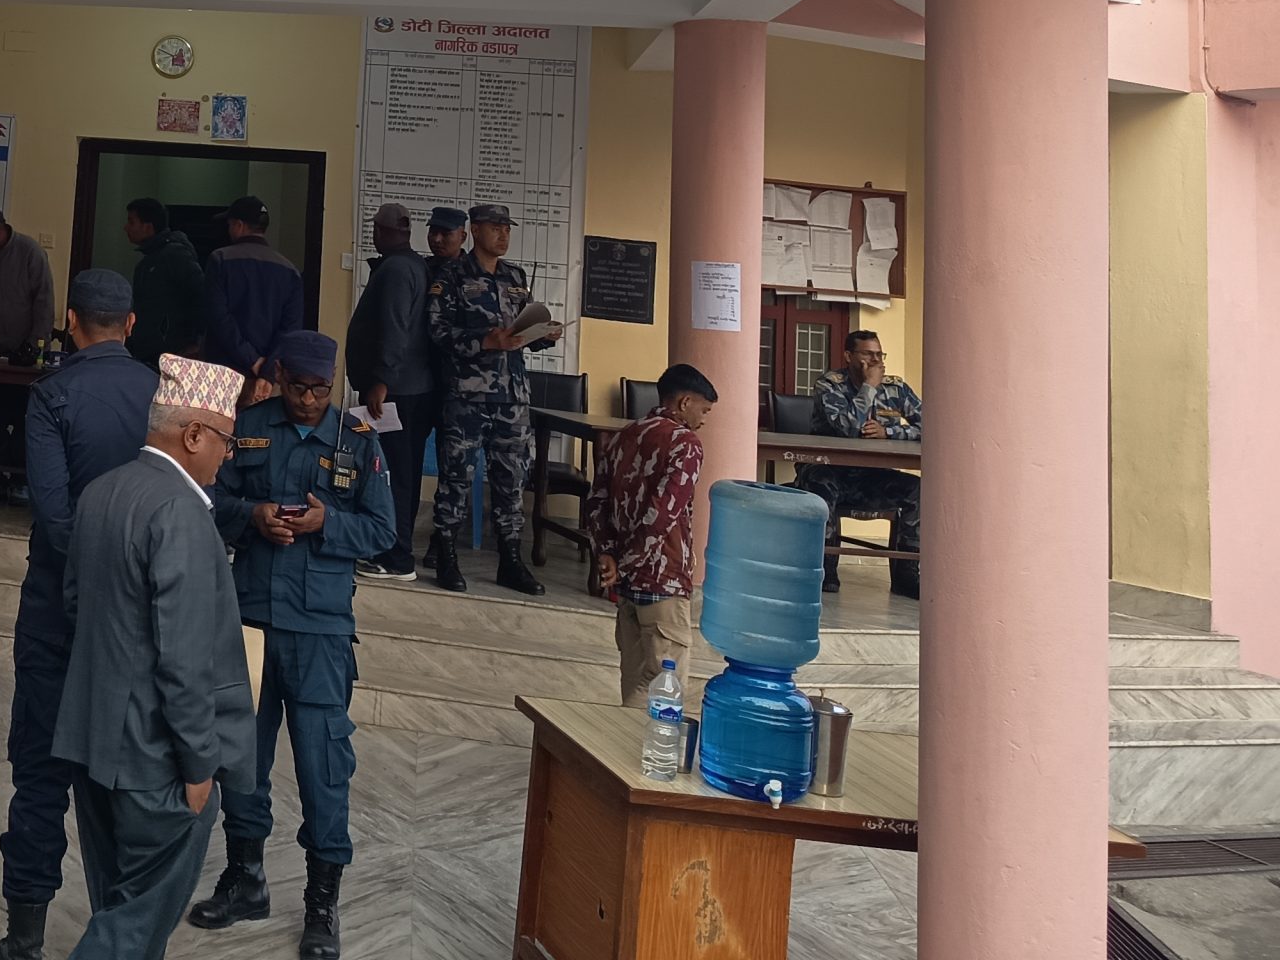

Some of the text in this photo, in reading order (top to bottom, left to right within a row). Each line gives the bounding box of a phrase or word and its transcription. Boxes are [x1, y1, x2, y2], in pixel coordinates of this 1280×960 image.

[401, 19, 551, 39] डोटी जिल्ला अदालत
[434, 37, 519, 56] नागरिक वडापत्र
